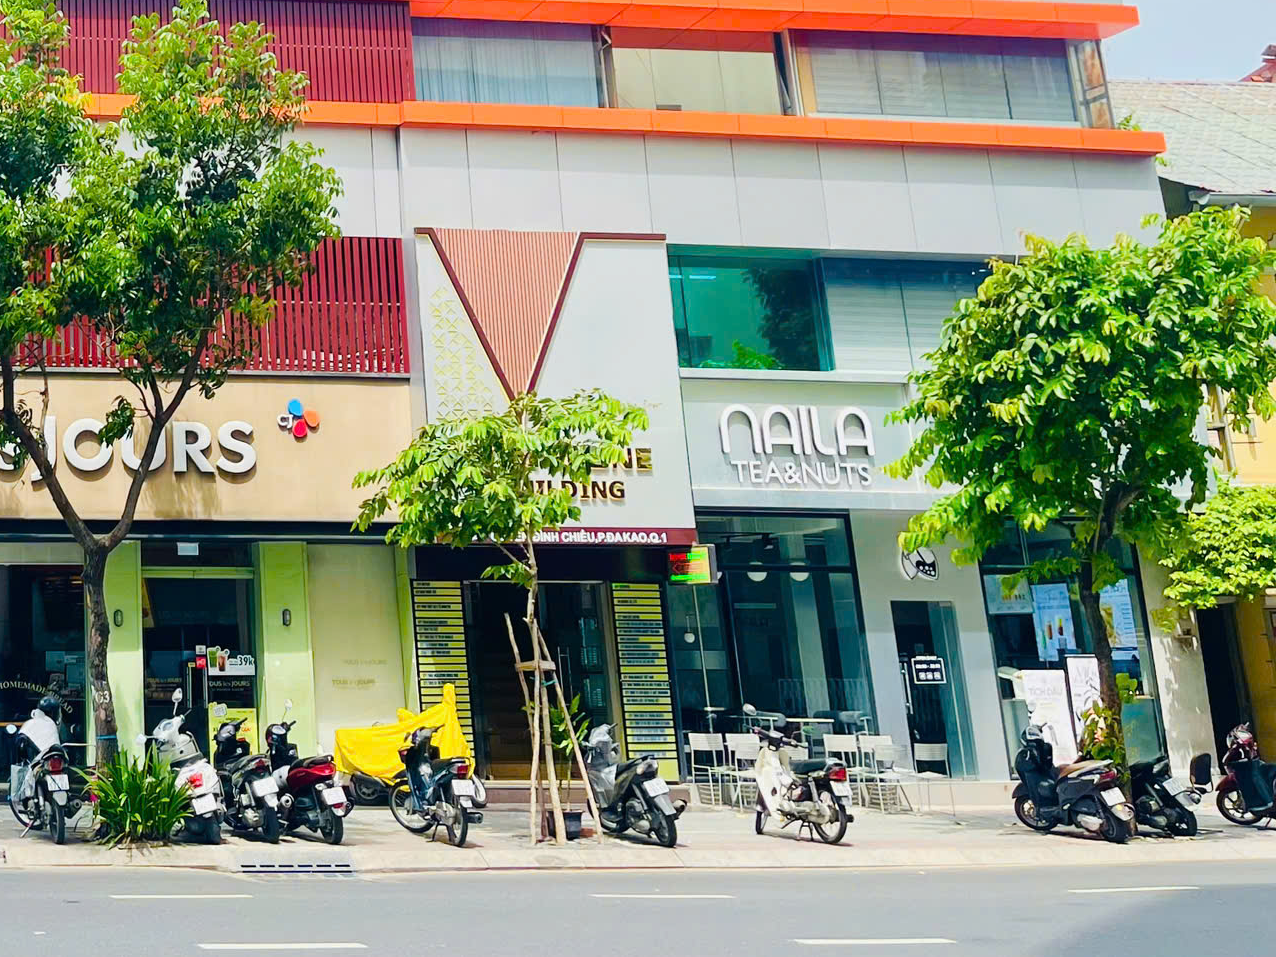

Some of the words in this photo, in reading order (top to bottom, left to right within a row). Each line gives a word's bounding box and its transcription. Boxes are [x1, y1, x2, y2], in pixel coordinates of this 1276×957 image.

[31, 416, 257, 481] JOURS
[720, 403, 876, 456] NAILA
[730, 461, 873, 486] TEA&NUTS
[238, 656, 254, 666] 39k
